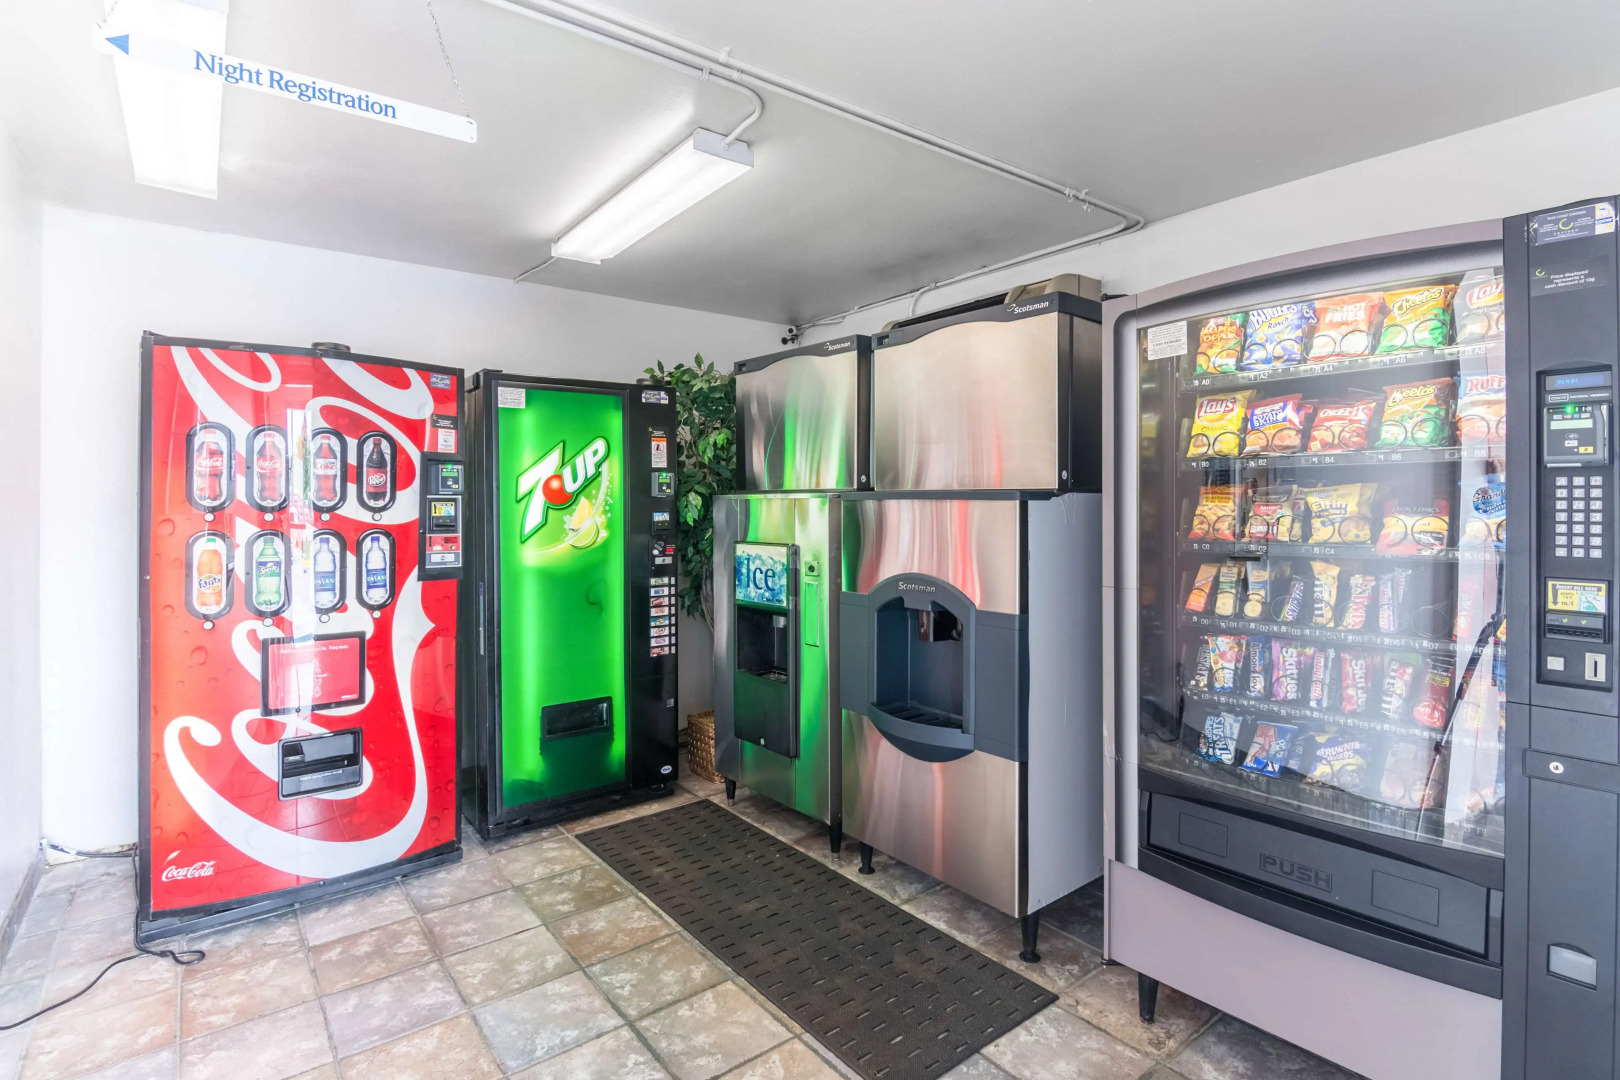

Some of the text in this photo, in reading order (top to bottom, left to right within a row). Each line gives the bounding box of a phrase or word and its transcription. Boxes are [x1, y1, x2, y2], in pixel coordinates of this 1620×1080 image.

[193, 49, 398, 120] Night Registration
[1564, 269, 1589, 278] displayed
[1557, 280, 1578, 288] discount
[1013, 300, 1049, 314] Scotsman
[1392, 287, 1445, 316] Cheetos
[1325, 310, 1366, 323] FRIES
[1266, 317, 1290, 330] Ranch
[827, 341, 851, 352] Scotsman
[1323, 364, 1334, 373] A4
[1259, 371, 1269, 380] A2
[1199, 396, 1238, 416] Lay's
[314, 460, 336, 471] Coke
[259, 566, 280, 576] Sprite
[744, 556, 776, 592] Ice
[897, 581, 937, 594] Scotsman
[1428, 642, 1440, 650] D7
[1282, 647, 1298, 700] Skittles
[1351, 659, 1368, 712] Skittles
[1214, 716, 1230, 760] TREATS
[1316, 741, 1361, 758] BROWNIE
[161, 860, 218, 882] Coca-Cola
[1260, 854, 1332, 889] PUSH
